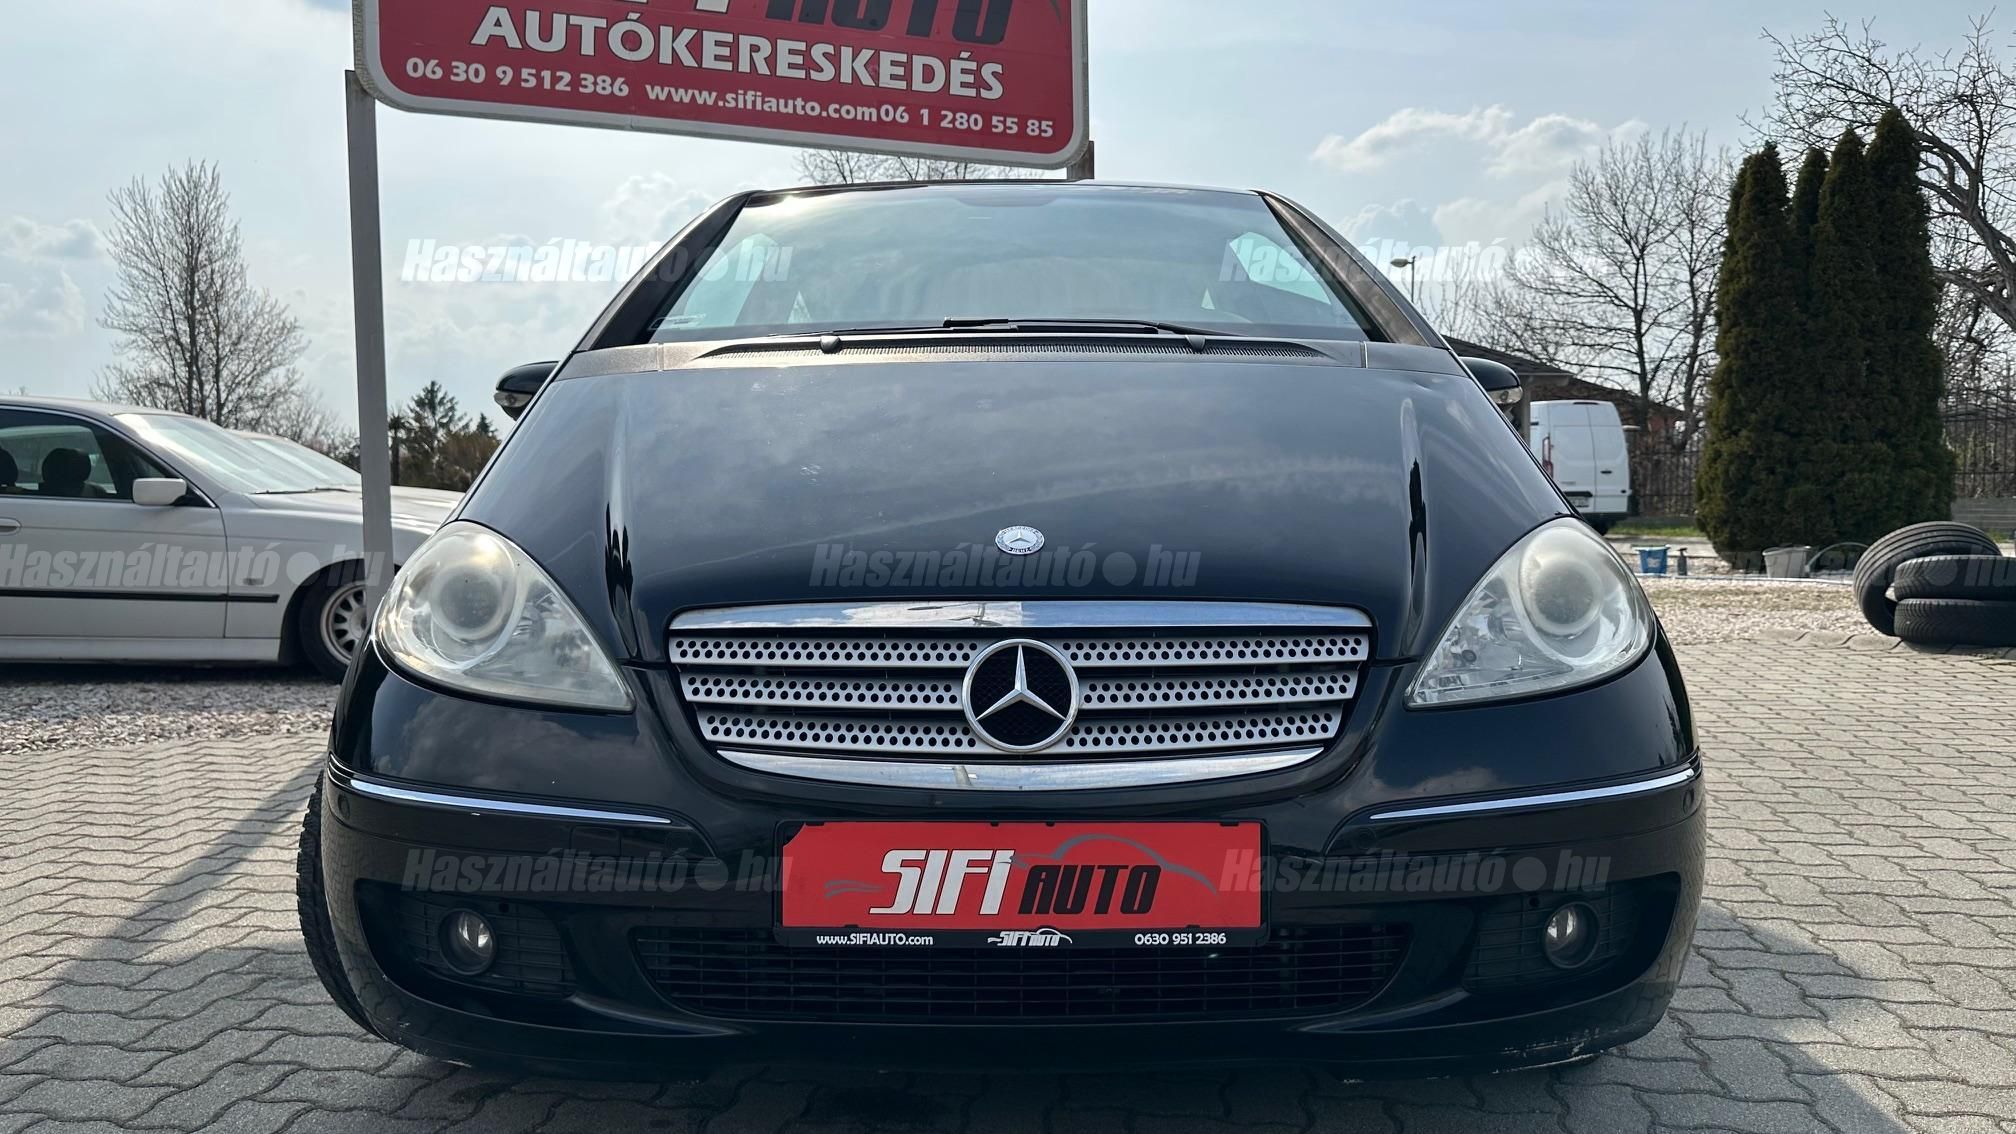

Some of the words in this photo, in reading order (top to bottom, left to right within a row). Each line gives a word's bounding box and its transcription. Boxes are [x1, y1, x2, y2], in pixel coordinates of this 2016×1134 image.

[470, 6, 1004, 100] AUTÓKERESKEDÉS
[406, 57, 443, 80] 06
[451, 61, 486, 83] 30
[579, 75, 629, 97] 386
[645, 83, 877, 122] www.sifiauto.com
[880, 104, 909, 124] 06
[919, 108, 929, 126] 1
[940, 110, 983, 131] 280
[991, 115, 1018, 134] 55
[1026, 120, 1053, 137] 85
[869, 849, 1014, 916] SIFI
[1017, 864, 1161, 916] AUTO
[816, 933, 934, 946] www.SIFIAUTO.com
[1134, 933, 1169, 945] 0630
[1172, 933, 1192, 945] 951
[1195, 932, 1227, 945] 2386
